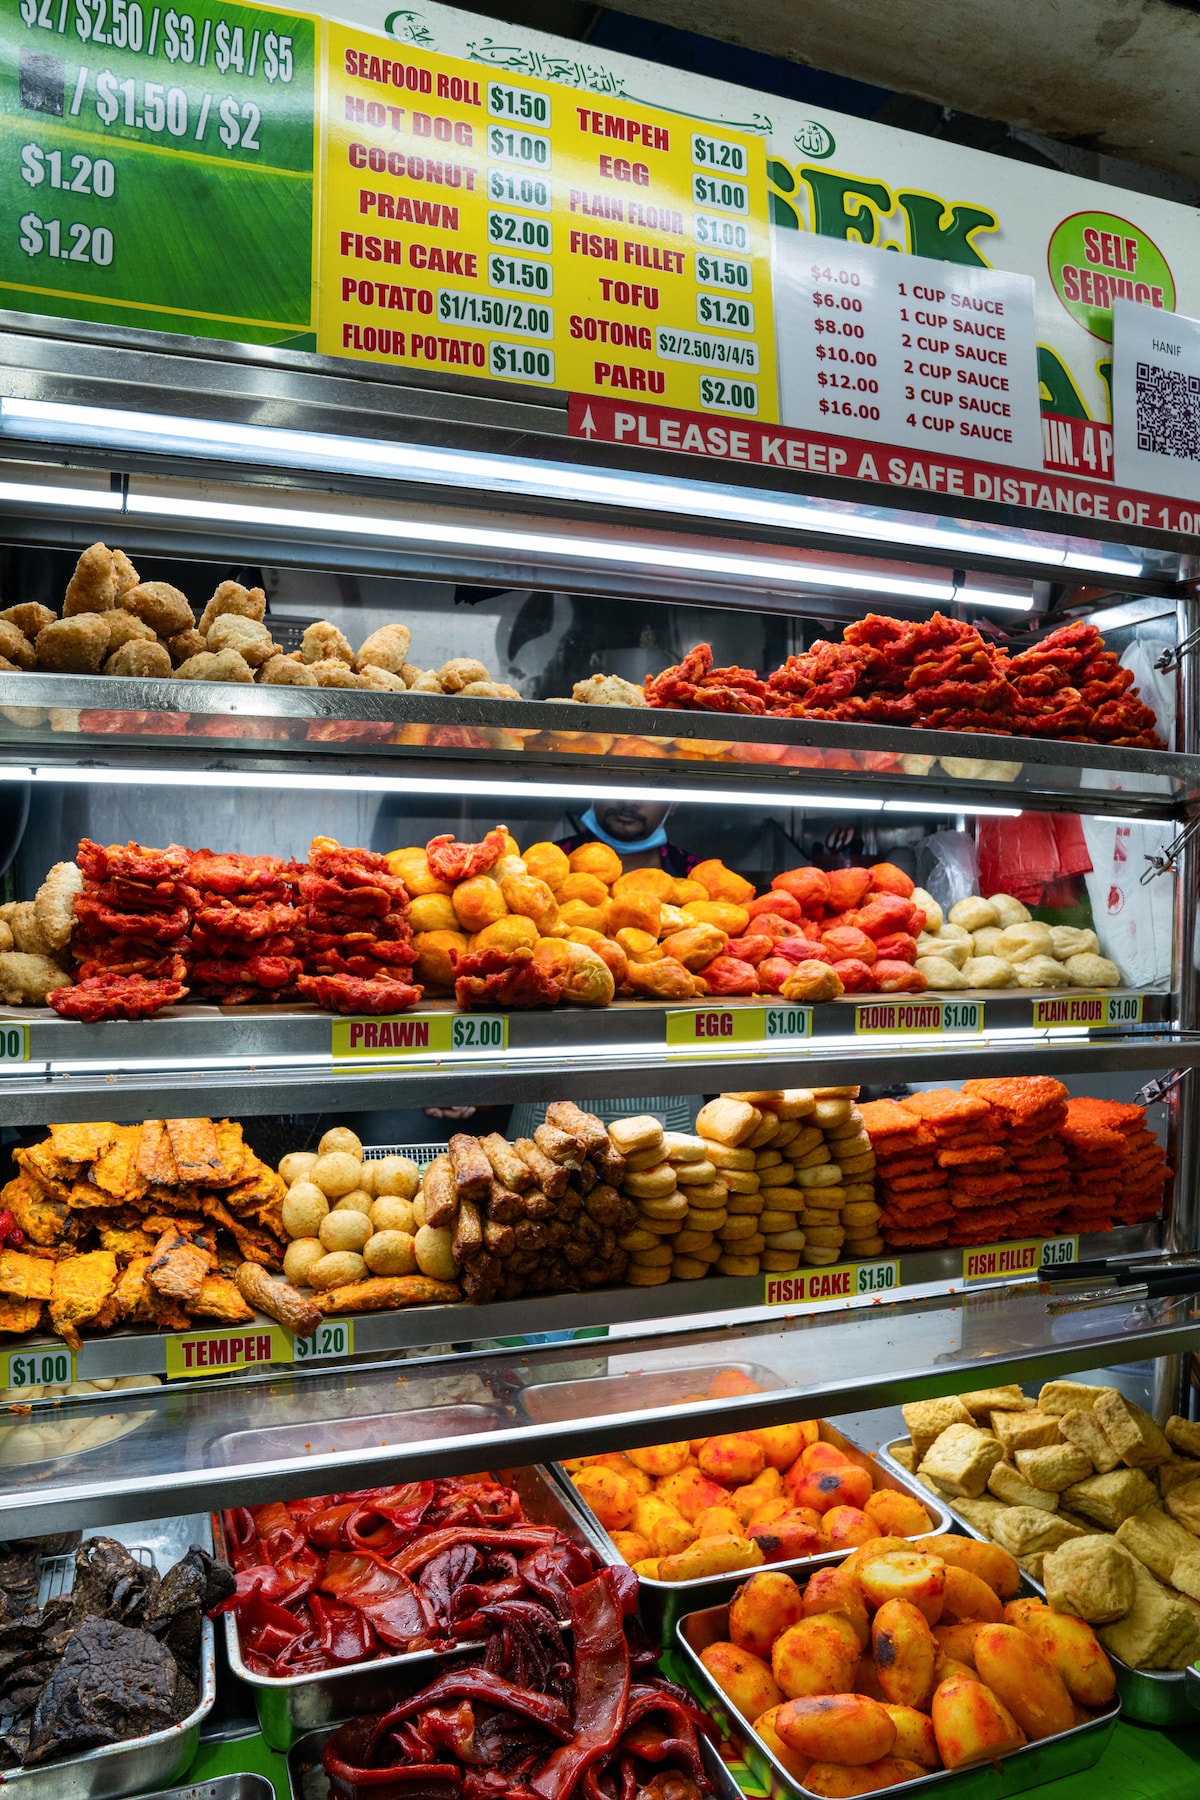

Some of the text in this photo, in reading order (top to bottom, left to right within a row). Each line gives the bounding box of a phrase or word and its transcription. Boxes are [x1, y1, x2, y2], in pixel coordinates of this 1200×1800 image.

[345, 49, 546, 121] SEAFOOD ROLL $1.50
[345, 95, 546, 163] HOT DOG $1.00
[576, 107, 743, 170] TEMPEH $1.20
[21, 142, 115, 198] $1.20
[349, 143, 547, 206] COCONUT $1.00
[599, 154, 745, 209] EGG $1.00
[20, 212, 114, 266] $1.20
[359, 190, 549, 247] PRAWN $2.00
[569, 189, 746, 248] PLAIN FLOUR $1.00
[340, 231, 548, 290] FISH CAKE $1.50
[570, 230, 748, 287] FISH FILLET $1.50
[1084, 228, 1137, 272] SELF
[341, 277, 549, 334] POTATO $1/1.50/2.00
[599, 278, 750, 327] TOFU $1.20
[811, 265, 1004, 316] $4.00 1 CUP SAUCE
[569, 315, 754, 366] SOTONG $2/2.50/3/4/5
[812, 292, 1006, 341] $6.00 1 CUP SAUCE
[342, 323, 550, 377] FLOUR POTATO $1.00
[814, 318, 1008, 366] $8.00 2 CUP SAUCE
[1152, 339, 1182, 357] HANIF
[594, 361, 755, 409] PARU $2.00
[816, 344, 1010, 391] $10.00 2 CUP SAUCE
[817, 371, 1012, 418] $12.00 3 CUP SAUCE
[819, 398, 1013, 443] $16.00 4 CUP SAUCE
[614, 411, 750, 460] PLEASE
[761, 435, 847, 473] KEEP
[856, 454, 880, 481] A
[888, 458, 964, 494] SAFE
[973, 472, 1109, 519] DISTANCE
[1117, 500, 1149, 526] OF
[350, 1020, 501, 1048] PRAWN $2.00
[695, 1010, 805, 1037] EGG $1.00
[860, 1005, 976, 1029] FLOUR POTATO $1.00
[1038, 1000, 1137, 1022] PLAIN FLOUR $1.00
[968, 1242, 1073, 1276] FISH FILLET $1.50
[768, 1266, 893, 1304] FISH CAKE $1.50
[12, 1356, 67, 1387] $1.00
[181, 1328, 344, 1368] TEMPEH $1.20
